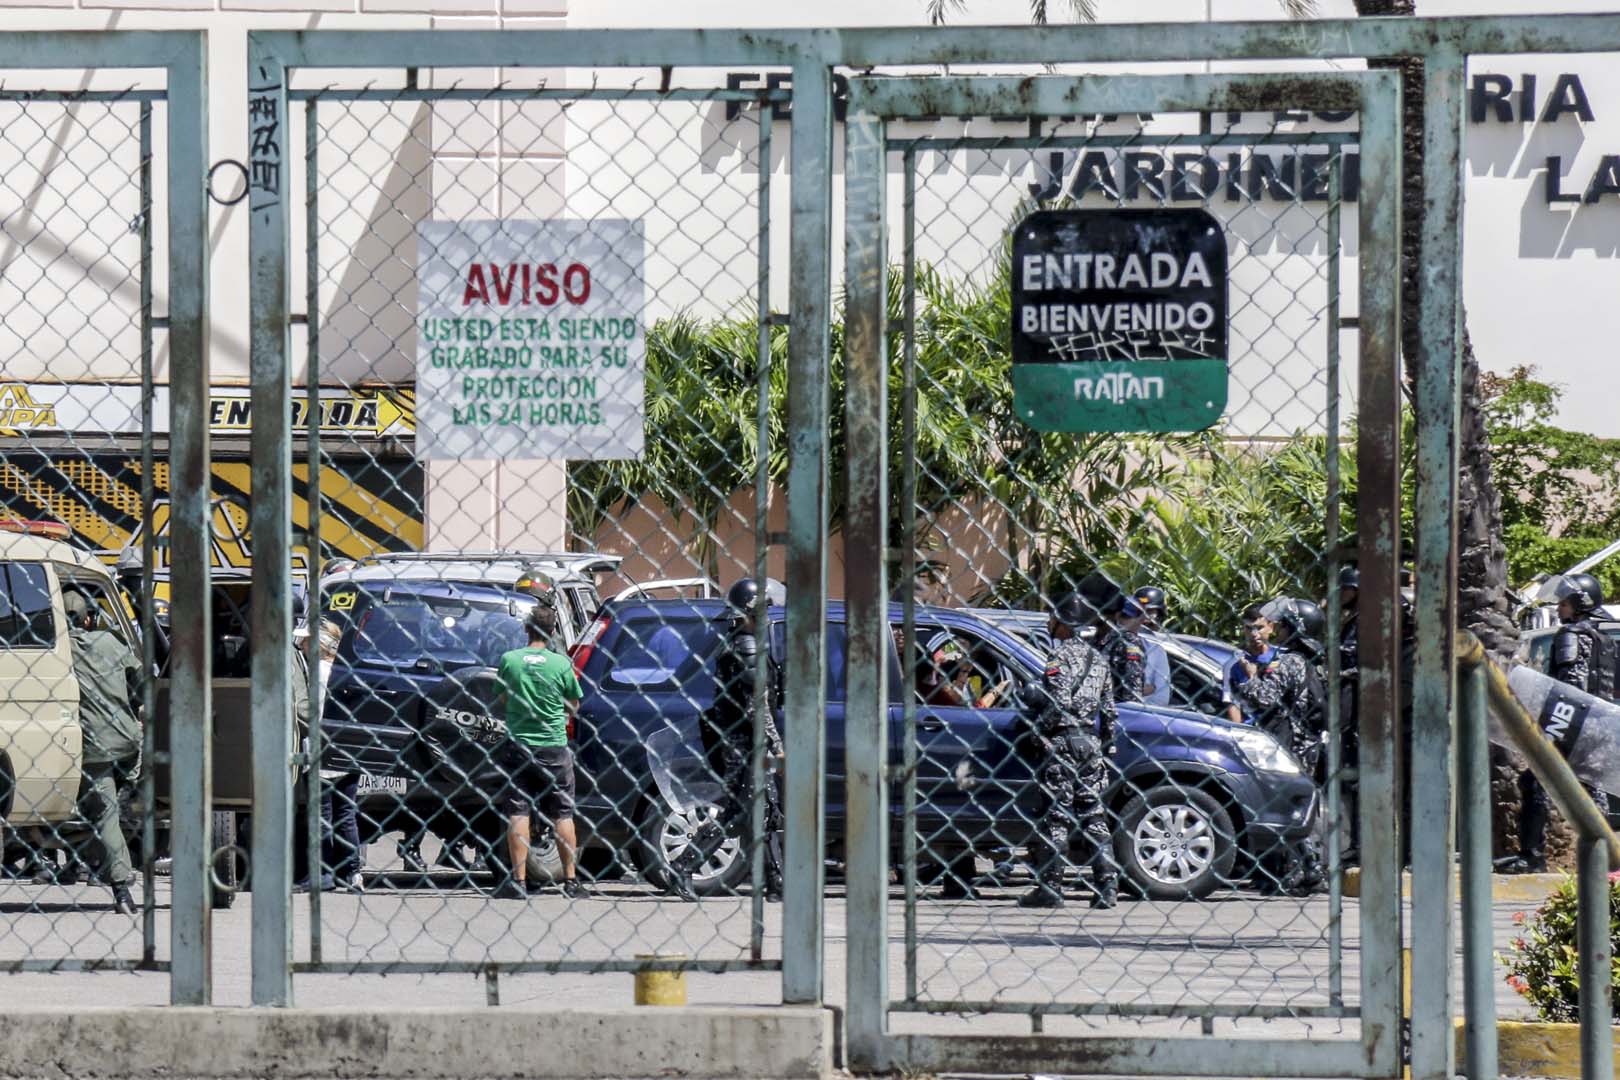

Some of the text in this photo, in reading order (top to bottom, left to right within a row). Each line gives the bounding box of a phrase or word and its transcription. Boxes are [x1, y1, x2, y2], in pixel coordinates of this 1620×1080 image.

[462, 262, 592, 306] AVISO
[1022, 252, 1213, 291] ENTRADA
[423, 317, 637, 342] USTED ESTA SIENDO
[1021, 302, 1215, 333] BIENVENIDO
[431, 347, 628, 370] GRABADO PARA SU
[462, 376, 597, 400] PROTECCION
[452, 403, 492, 426] LAS
[497, 404, 523, 426] 24
[1544, 701, 1576, 741] NB
